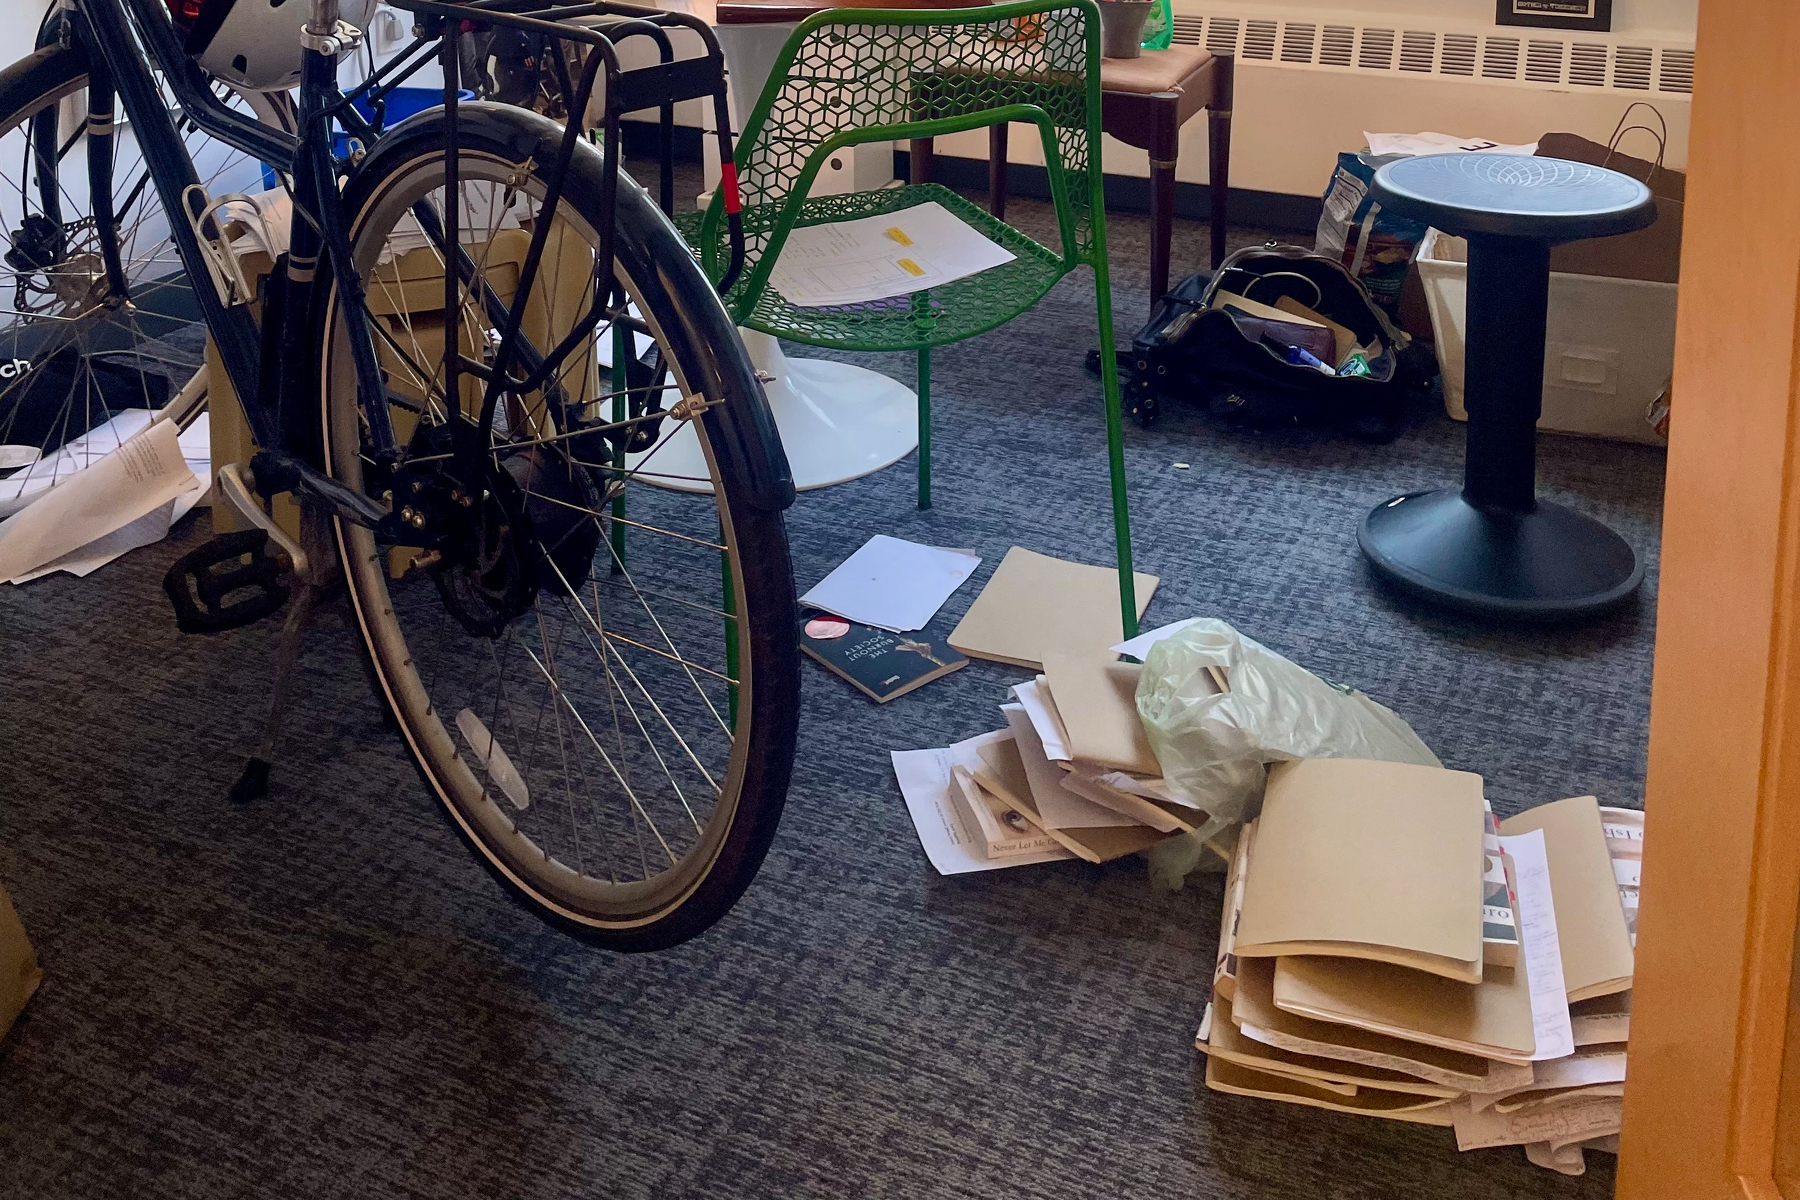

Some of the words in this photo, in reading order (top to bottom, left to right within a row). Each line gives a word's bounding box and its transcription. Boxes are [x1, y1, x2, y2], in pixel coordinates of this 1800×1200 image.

[844, 635, 885, 657] SOCIETY
[850, 638, 895, 662] BURNOUT
[869, 648, 888, 659] THE
[993, 843, 1016, 852] Never
[1018, 840, 1031, 850] Let
[1034, 839, 1045, 847] Me
